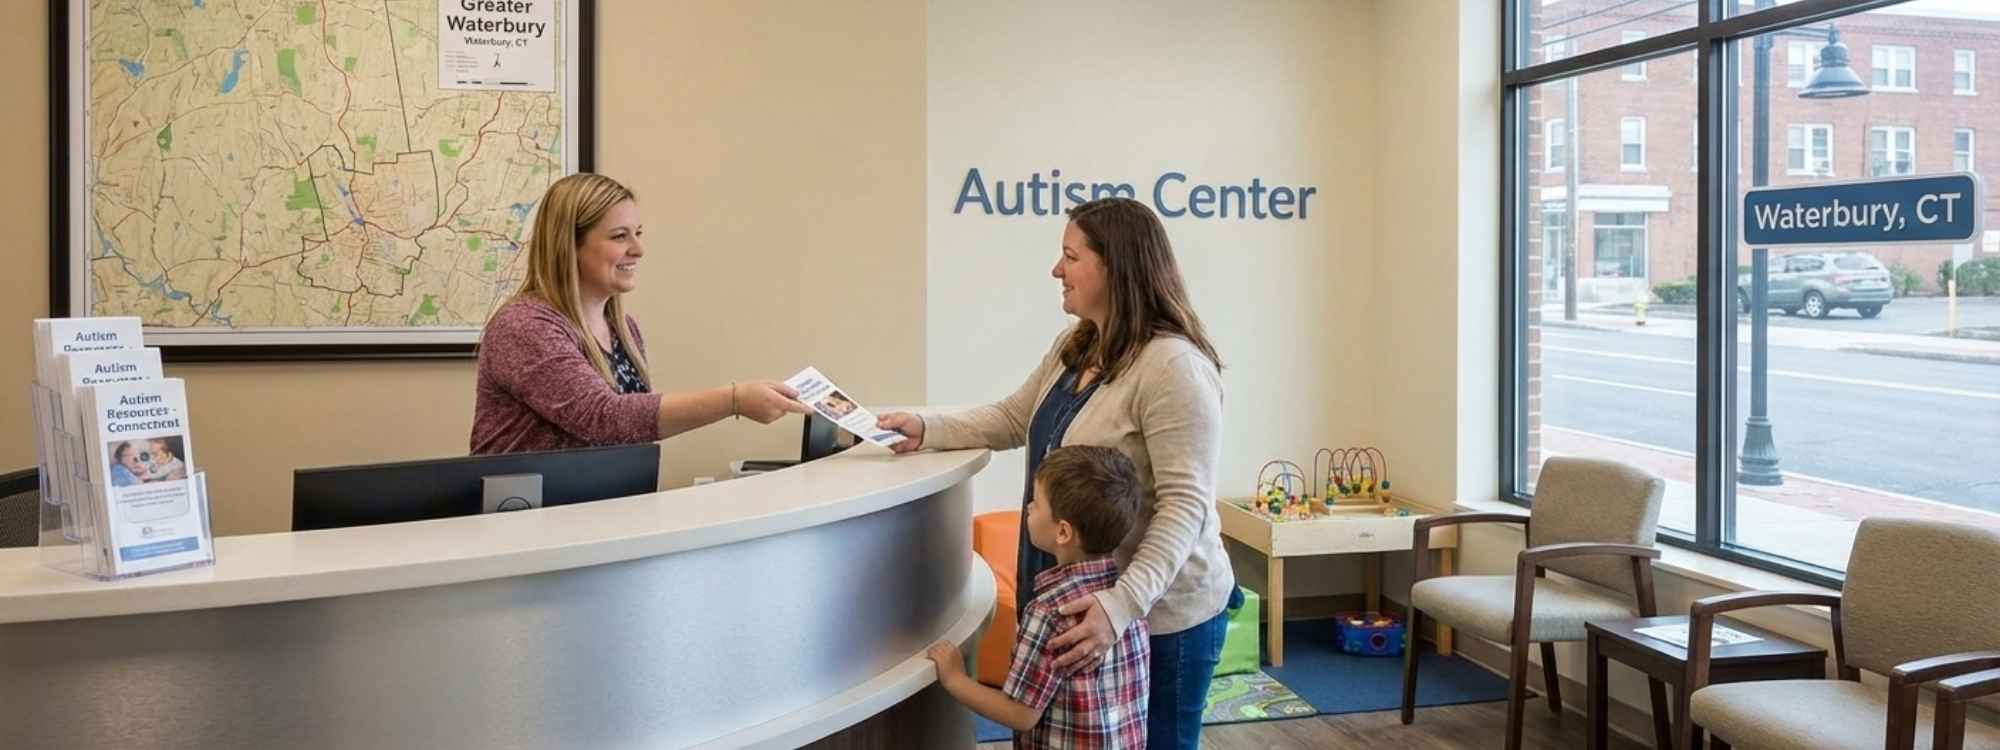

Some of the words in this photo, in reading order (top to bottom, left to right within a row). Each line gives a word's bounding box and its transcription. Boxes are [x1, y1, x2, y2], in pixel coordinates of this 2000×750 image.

[460, 0, 533, 13] Greater
[447, 15, 546, 38] Waterbury
[515, 38, 528, 47] CT
[1153, 172, 1317, 220] Center
[1754, 198, 1905, 231] Waterbury,
[1915, 192, 1962, 224] CT
[75, 331, 118, 342] Autism
[95, 362, 137, 374] Autism
[119, 393, 162, 406] Autism
